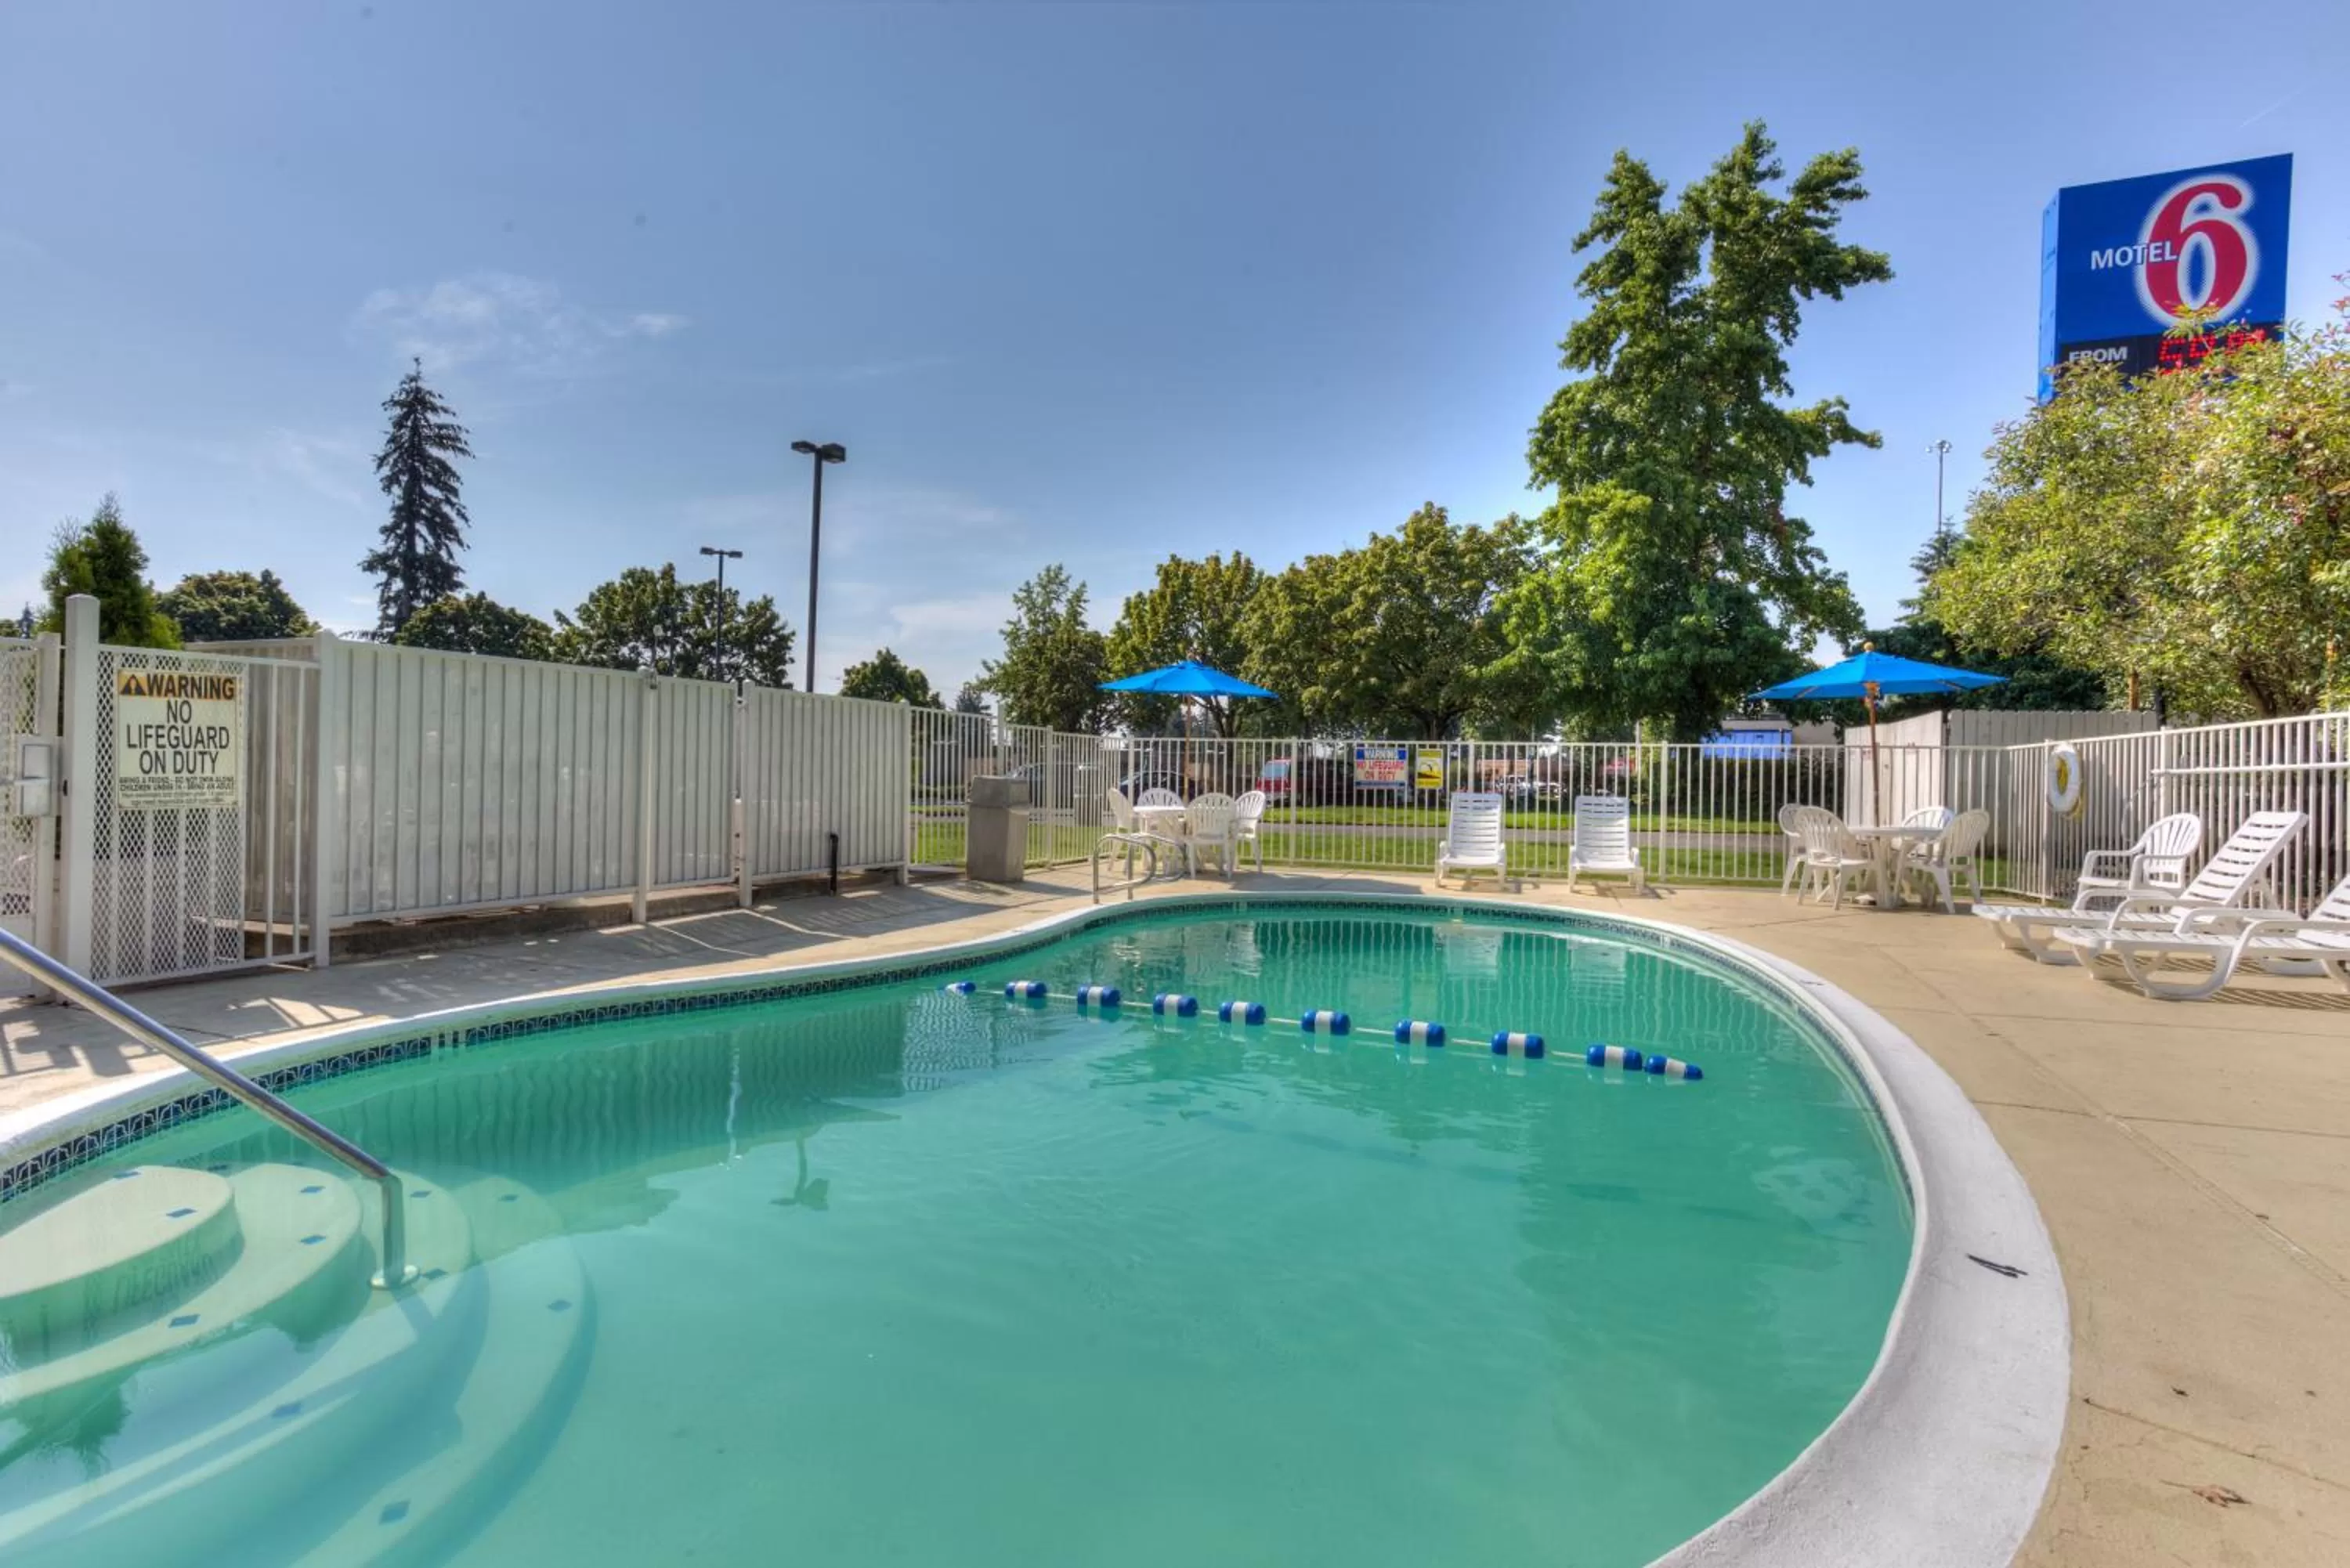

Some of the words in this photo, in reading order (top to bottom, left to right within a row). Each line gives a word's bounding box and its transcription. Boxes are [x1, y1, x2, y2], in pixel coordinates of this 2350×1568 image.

[2090, 240, 2178, 270] MOTEL
[2140, 177, 2253, 323] 6
[146, 674, 235, 700] WARNING
[166, 699, 193, 724] NO
[126, 724, 230, 750] LIFEGUARD
[139, 750, 167, 775] ON
[172, 750, 220, 775] DUTY
